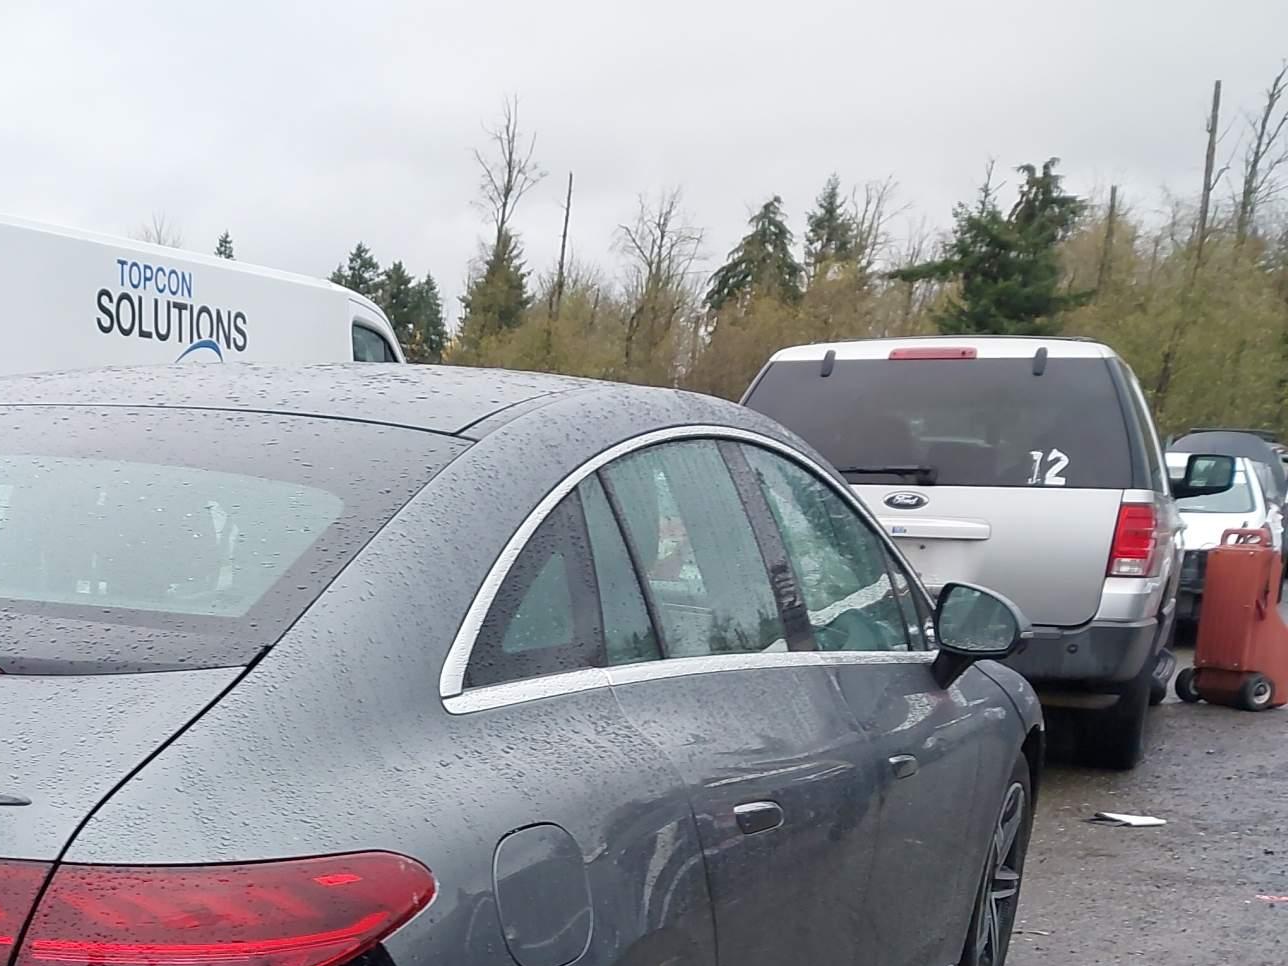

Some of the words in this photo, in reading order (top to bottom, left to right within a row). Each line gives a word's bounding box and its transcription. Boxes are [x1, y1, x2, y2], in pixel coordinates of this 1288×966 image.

[116, 259, 193, 298] TOPCON
[96, 288, 247, 352] SOLUTIONS
[1027, 449, 1069, 485] 12
[893, 494, 919, 504] Ford
